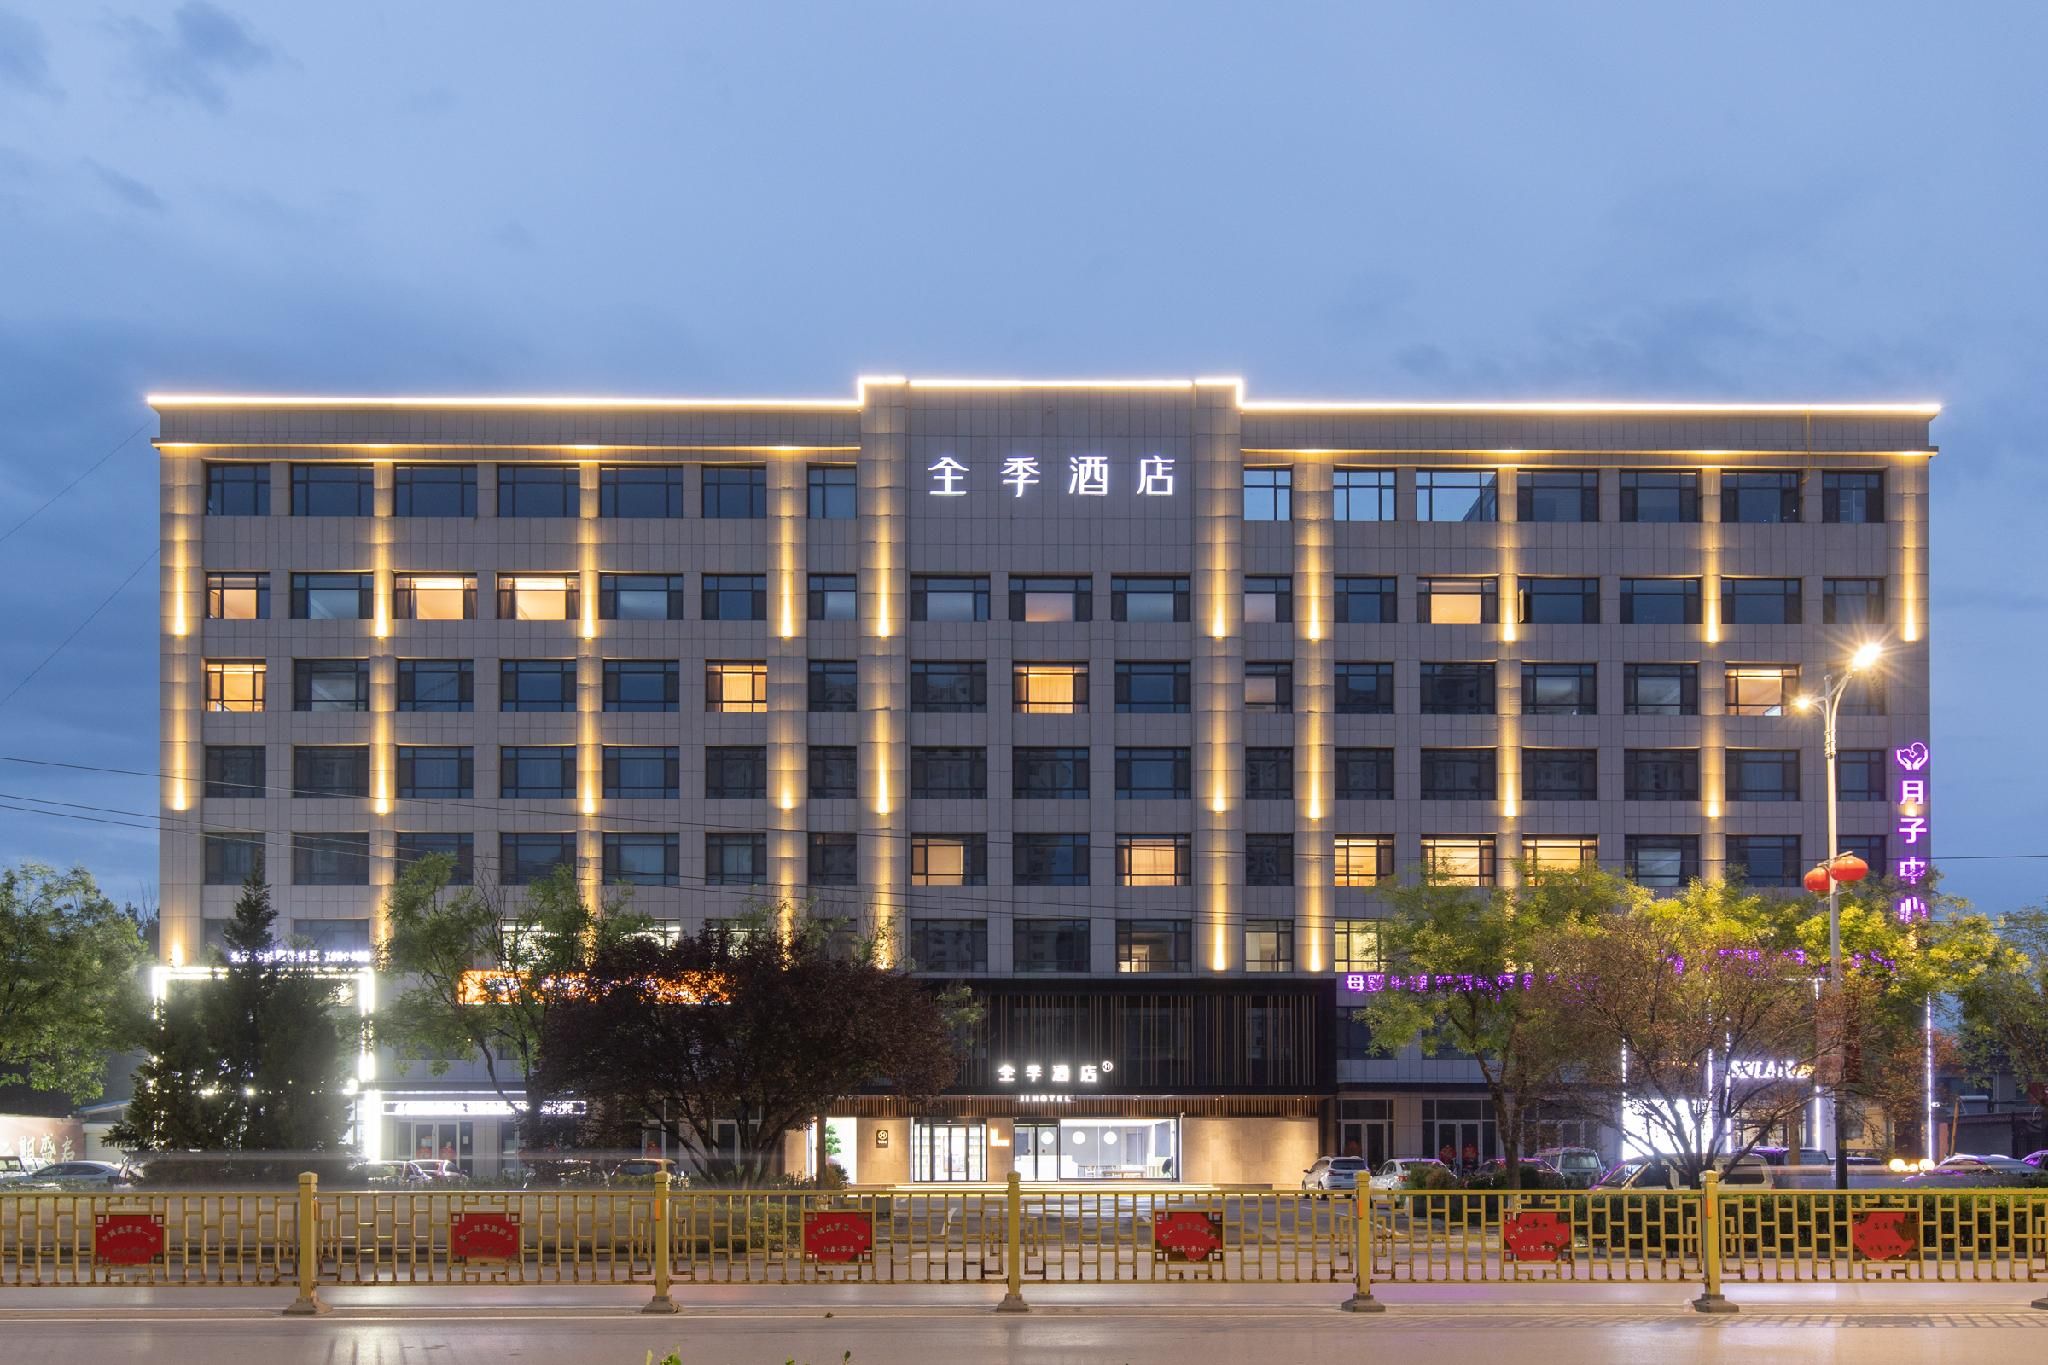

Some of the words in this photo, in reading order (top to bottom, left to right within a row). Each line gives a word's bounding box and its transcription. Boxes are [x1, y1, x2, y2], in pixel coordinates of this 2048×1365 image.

[927, 455, 1176, 498] 全季酒店
[997, 1063, 1098, 1083] 全季酒店
